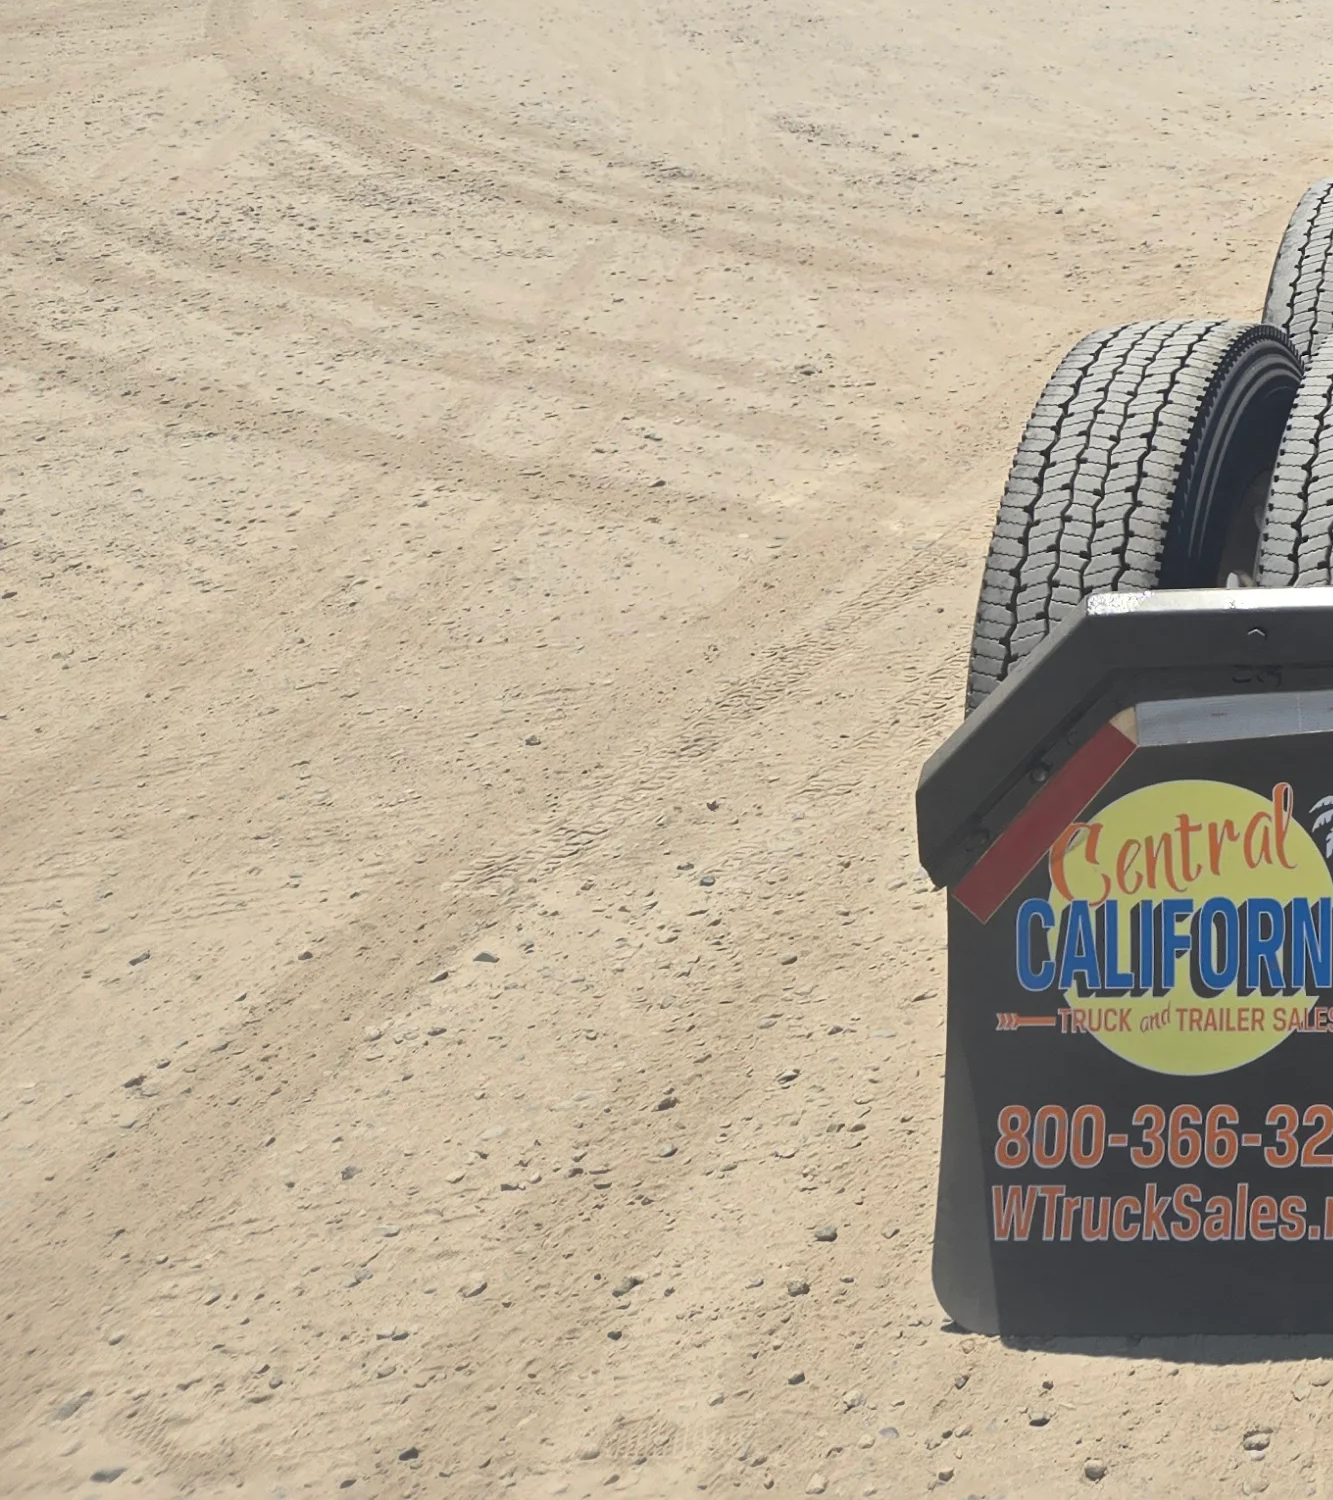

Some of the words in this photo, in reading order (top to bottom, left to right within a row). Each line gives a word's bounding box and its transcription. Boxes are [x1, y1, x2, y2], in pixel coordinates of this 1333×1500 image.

[1049, 781, 1296, 906] Central
[1057, 1007, 1133, 1034] TRUCK
[1139, 1002, 1173, 1034] and
[1176, 1007, 1265, 1033] TRAILER
